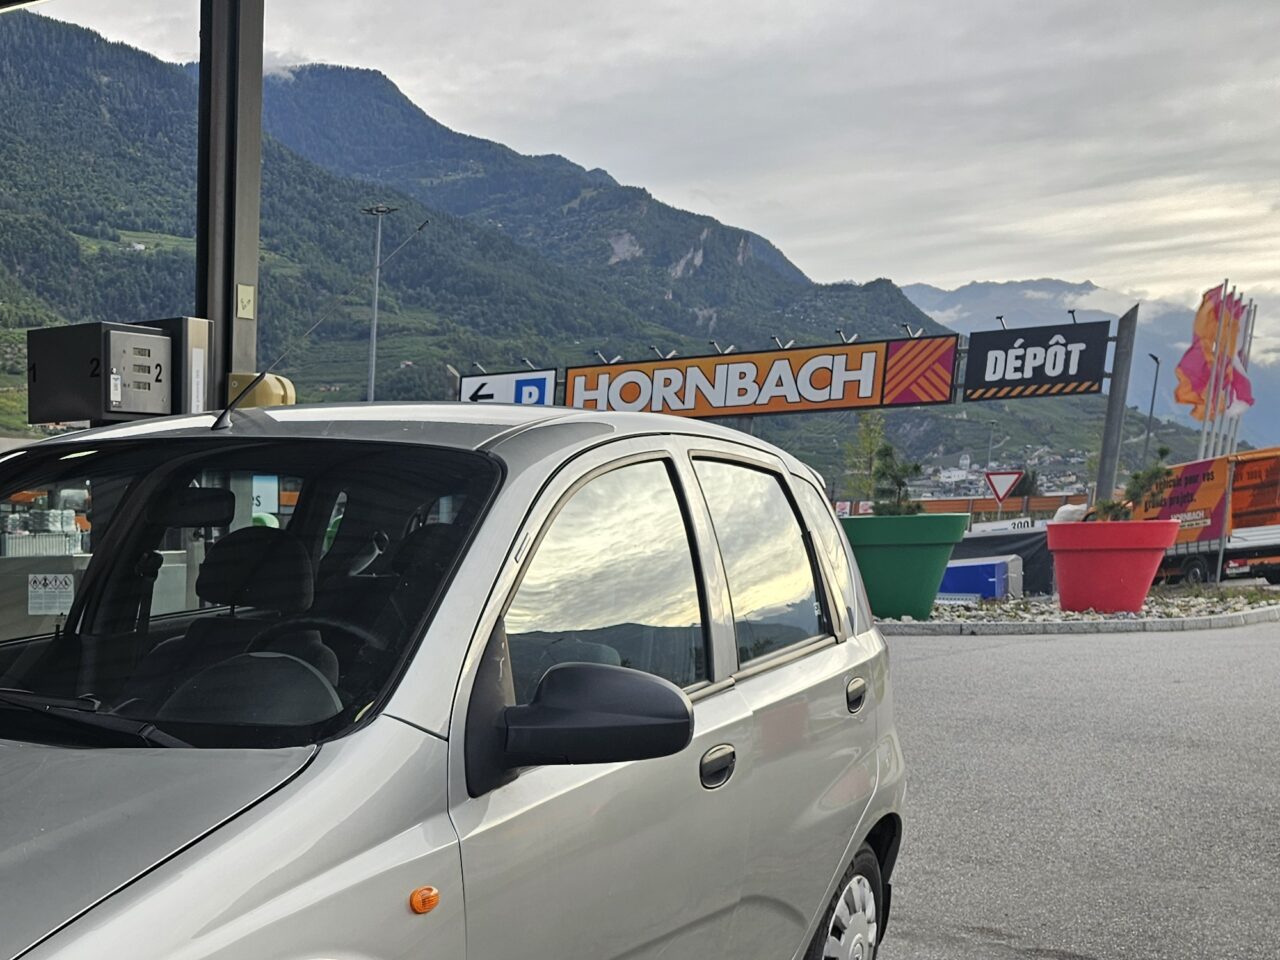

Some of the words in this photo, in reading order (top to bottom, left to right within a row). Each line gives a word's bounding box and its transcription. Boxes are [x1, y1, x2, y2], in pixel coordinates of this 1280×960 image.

[89, 358, 100, 378] 2
[154, 363, 163, 383] 2
[984, 334, 1087, 382] DÉPÔT
[573, 351, 877, 412] HORNBACH
